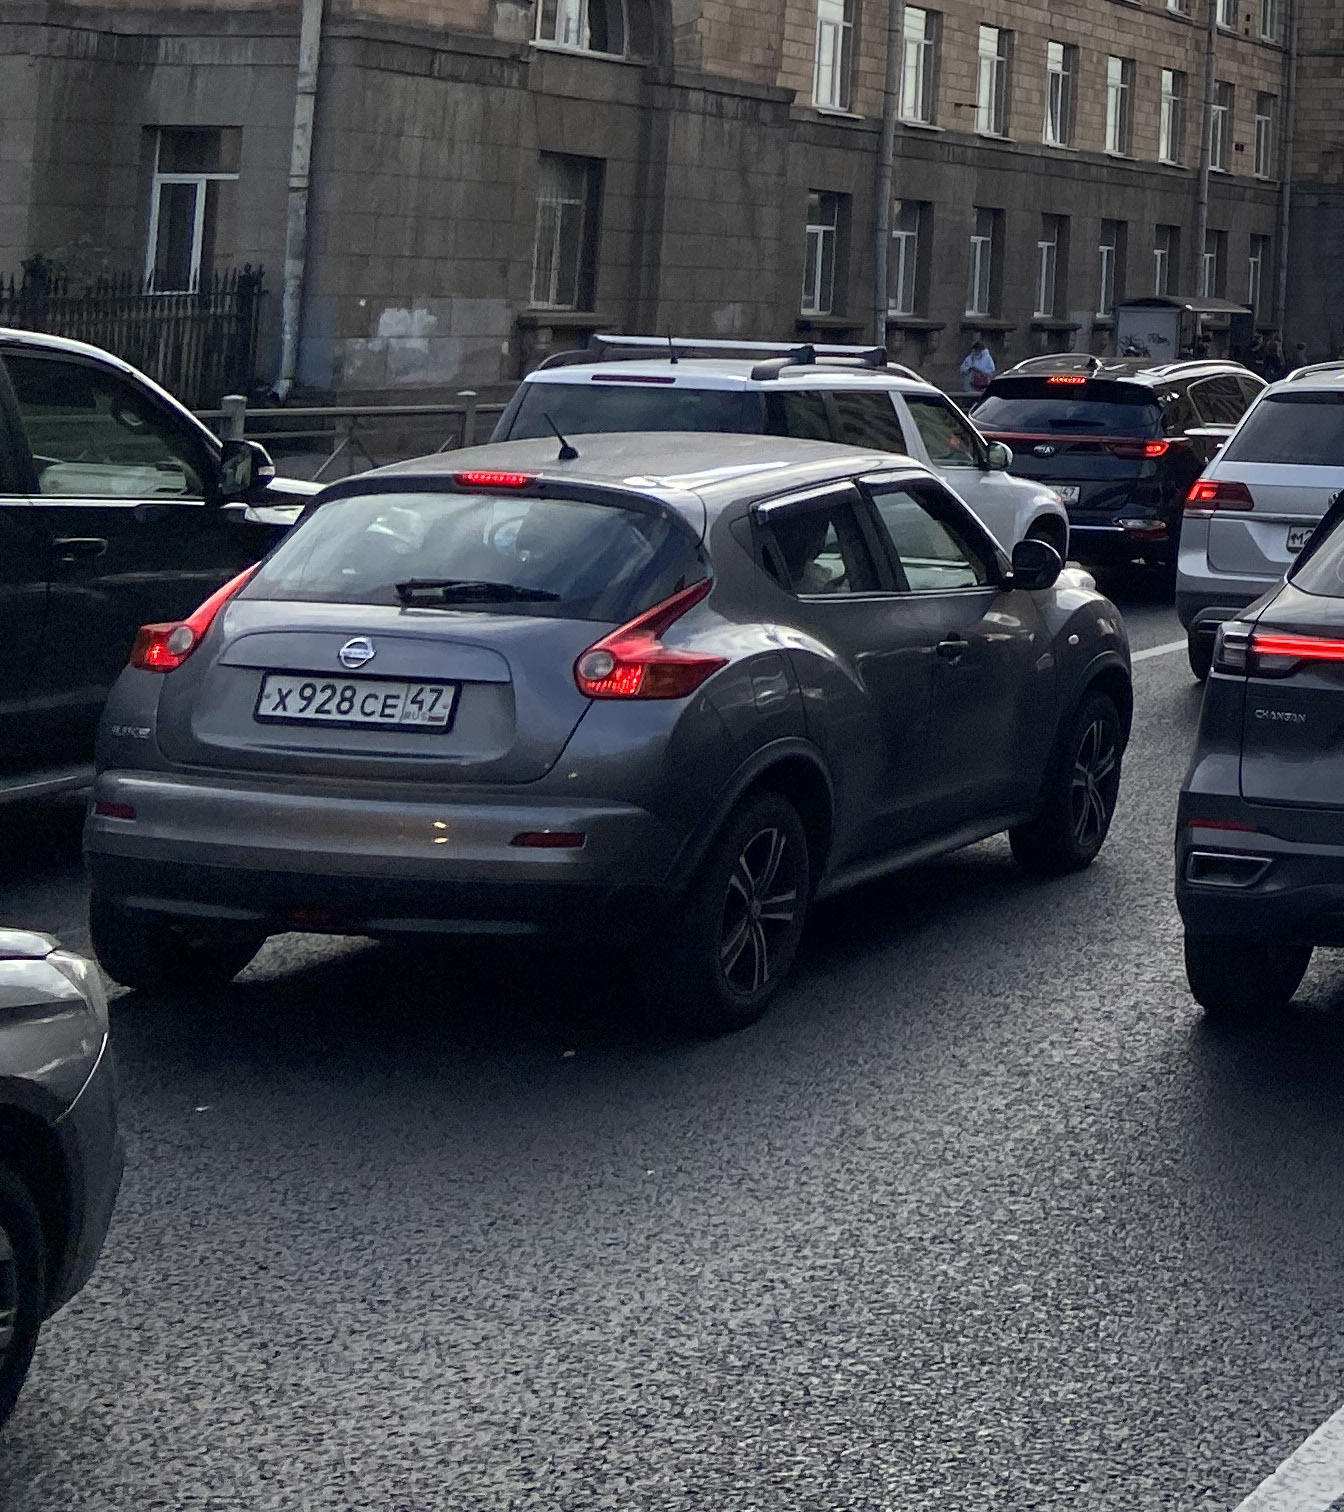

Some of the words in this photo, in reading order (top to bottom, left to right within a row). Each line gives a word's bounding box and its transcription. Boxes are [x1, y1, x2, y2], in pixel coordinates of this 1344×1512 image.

[271, 682, 400, 718] Х928СЕ
[410, 687, 444, 713] 47
[402, 711, 428, 721] RUS
